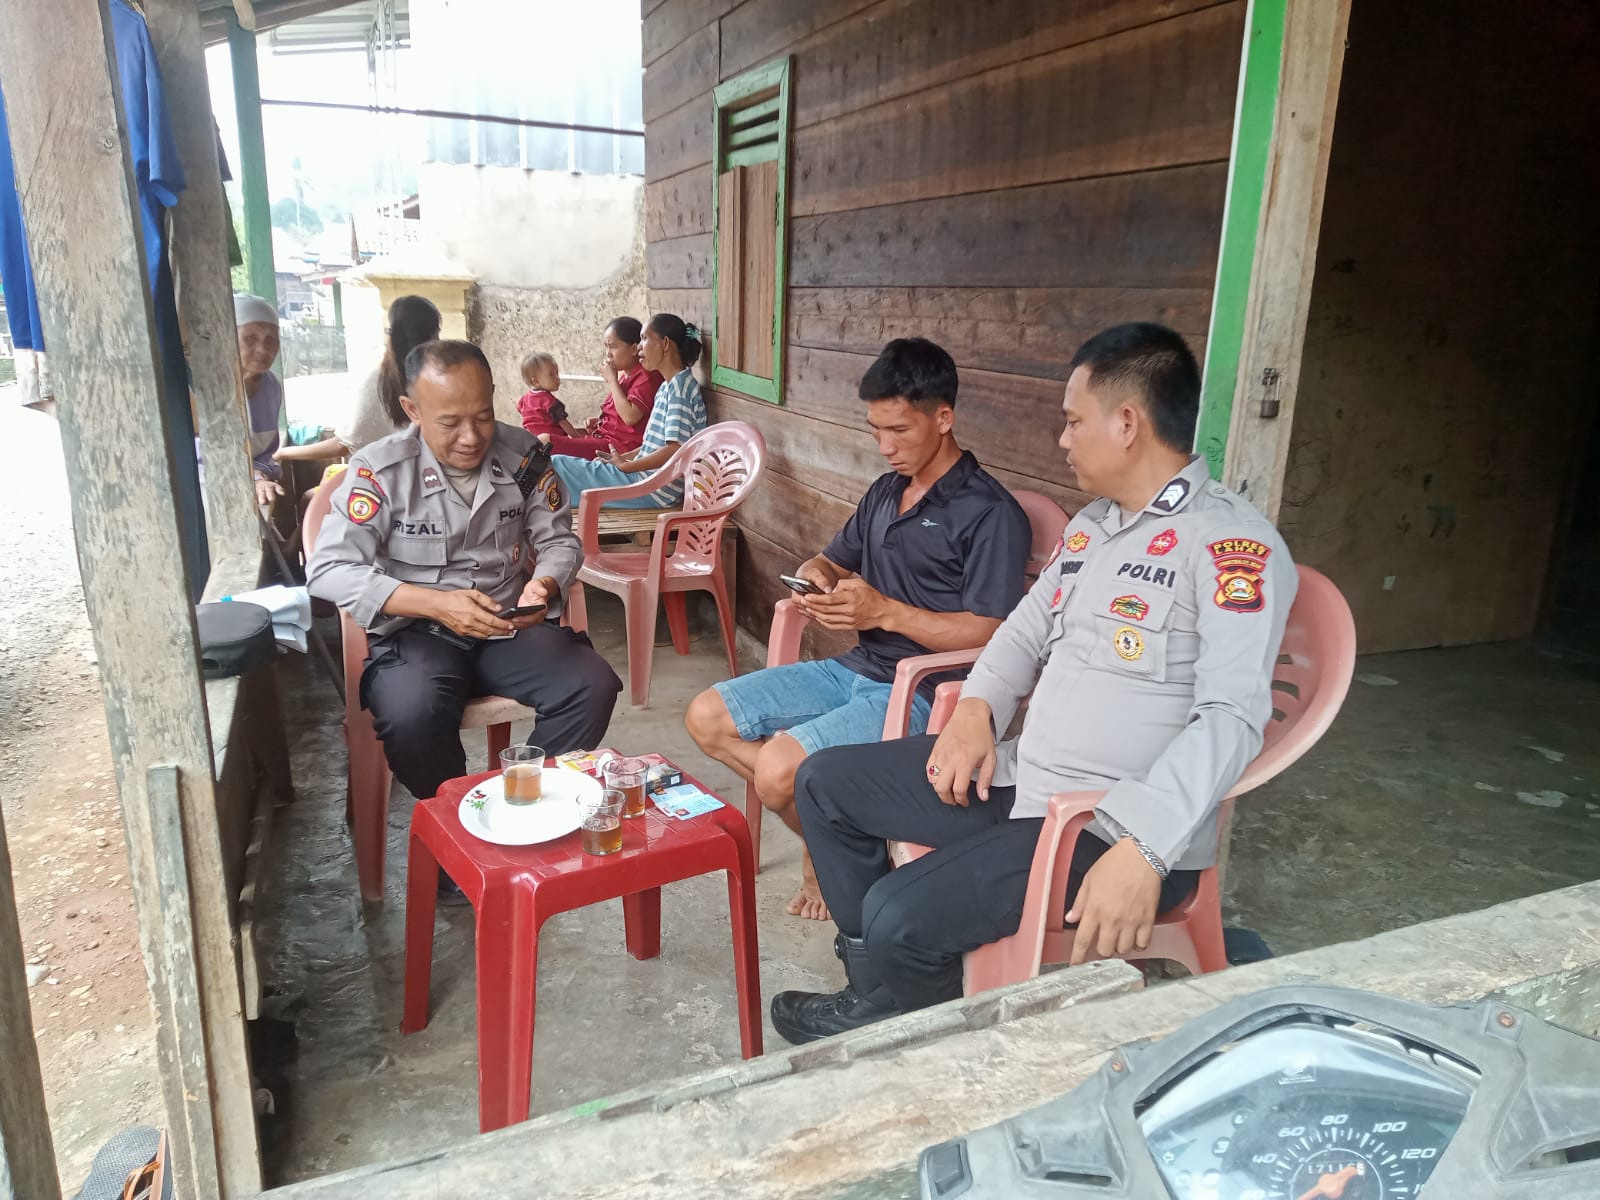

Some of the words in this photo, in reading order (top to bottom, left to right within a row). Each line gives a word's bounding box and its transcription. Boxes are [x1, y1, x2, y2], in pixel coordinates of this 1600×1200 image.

[1117, 562, 1176, 588] POLRI
[1321, 1114, 1348, 1125] 80
[1278, 1127, 1305, 1137] 60
[1372, 1121, 1407, 1133] 100
[1252, 1153, 1277, 1164] 40
[1401, 1148, 1436, 1159] 120
